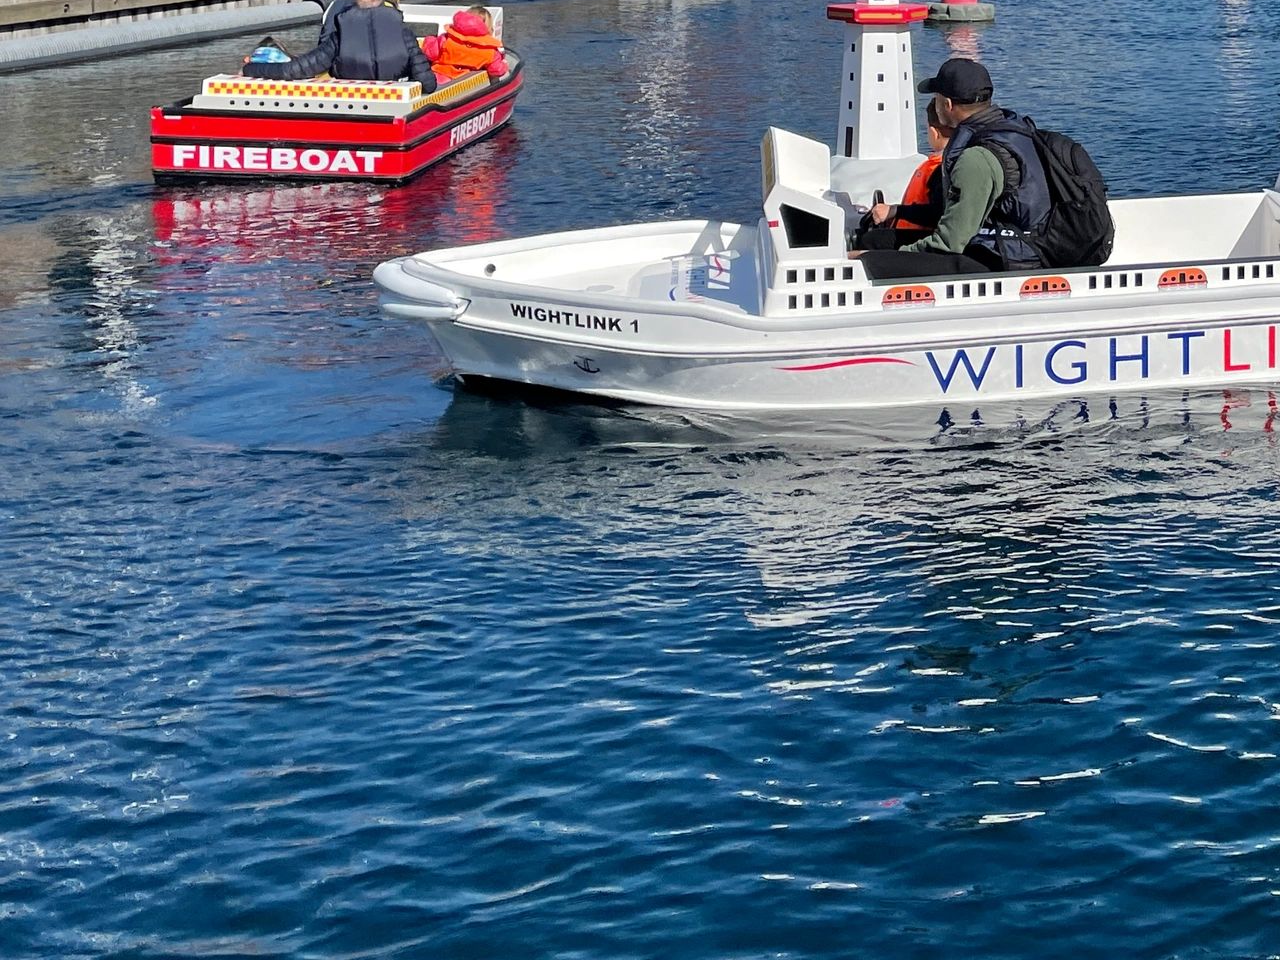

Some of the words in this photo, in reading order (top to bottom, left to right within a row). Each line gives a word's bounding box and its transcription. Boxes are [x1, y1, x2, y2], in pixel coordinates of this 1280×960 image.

[450, 106, 497, 148] FIREBOAT
[173, 144, 384, 173] FIREBOAT
[510, 303, 623, 332] WIGHTLINK
[629, 319, 640, 333] 1
